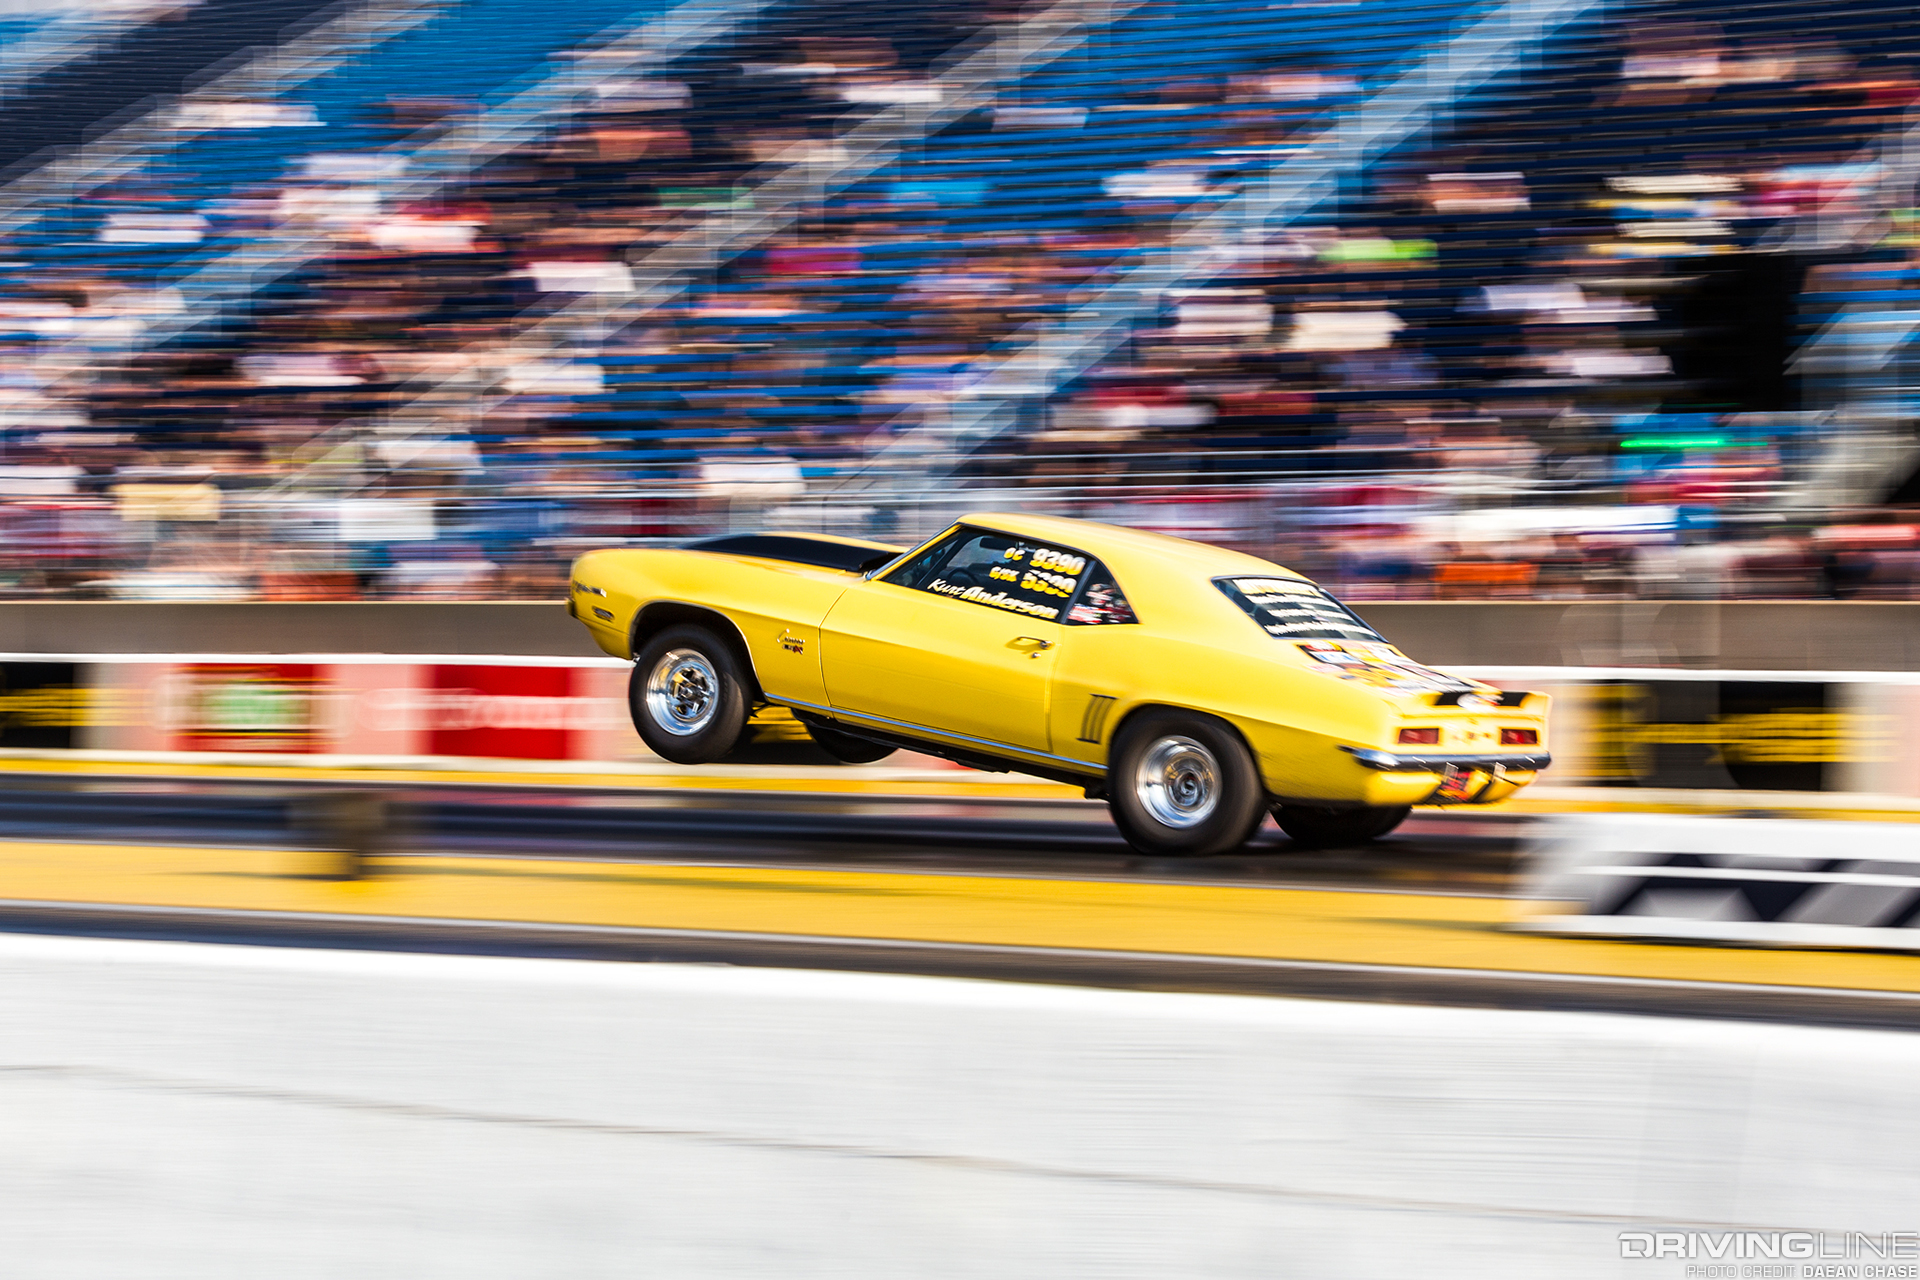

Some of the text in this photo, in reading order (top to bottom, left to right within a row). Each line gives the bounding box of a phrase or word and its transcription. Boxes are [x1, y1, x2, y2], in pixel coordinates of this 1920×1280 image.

[1029, 548, 1086, 575] 9390
[927, 578, 1060, 619] Kurt Anderson
